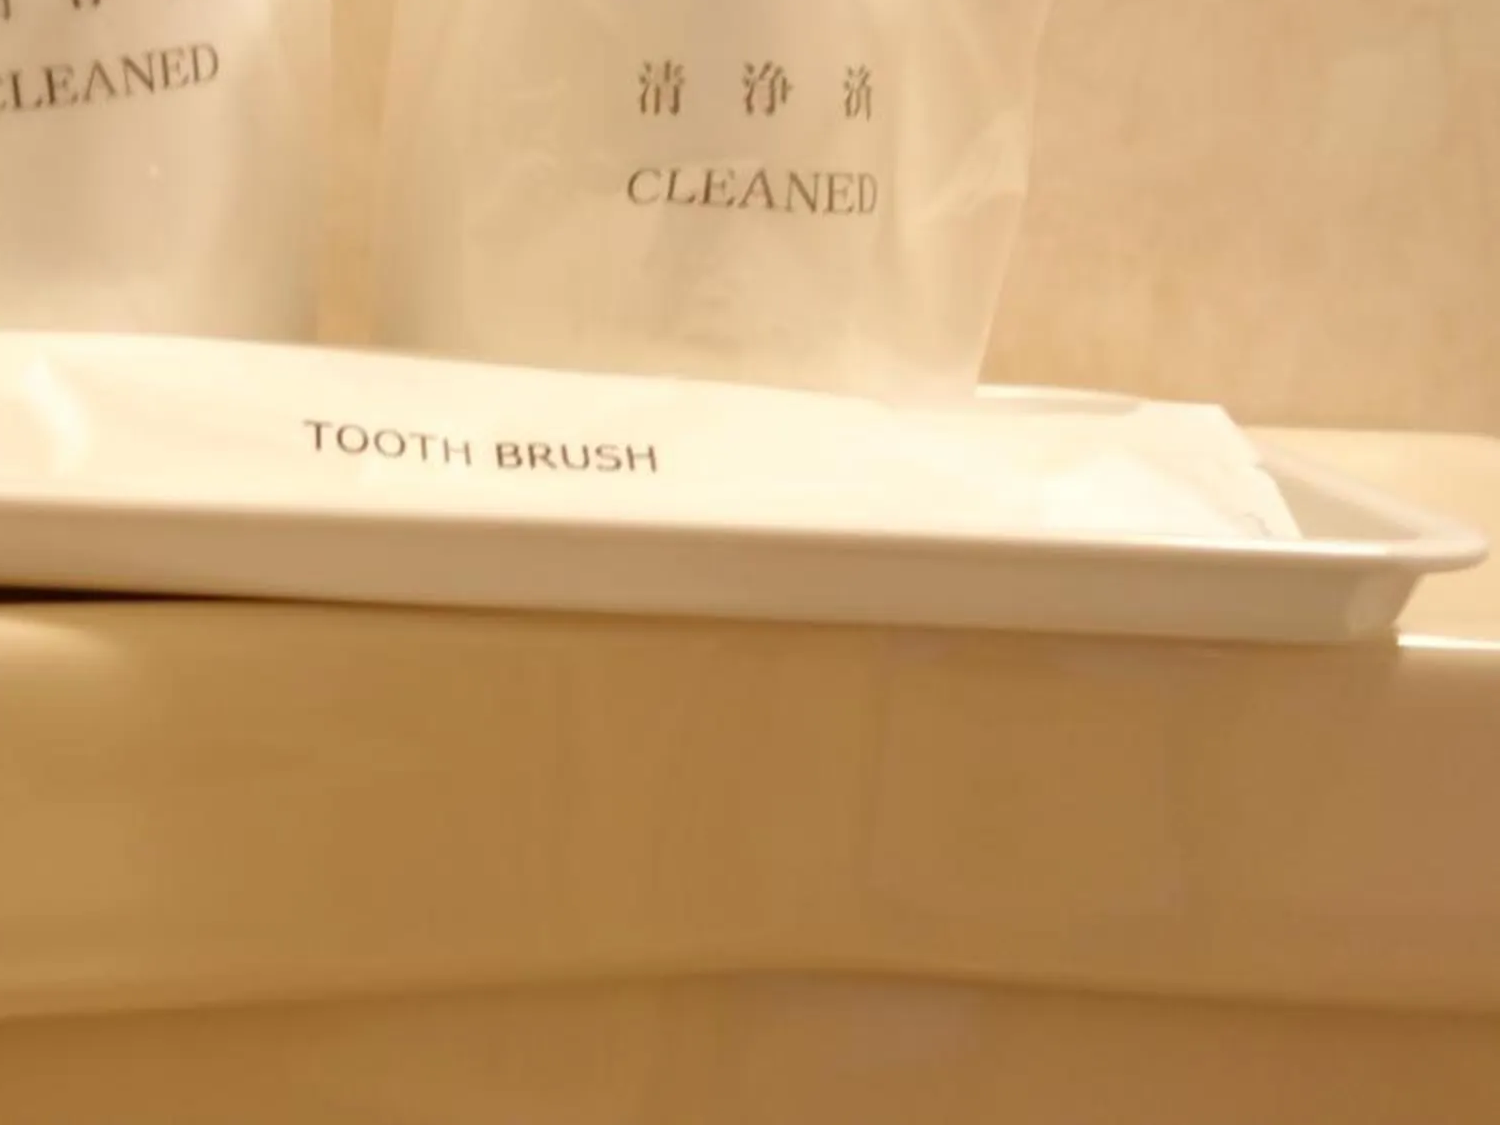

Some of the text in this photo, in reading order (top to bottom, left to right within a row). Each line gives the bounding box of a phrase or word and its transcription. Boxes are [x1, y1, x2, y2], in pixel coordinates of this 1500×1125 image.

[627, 167, 878, 215] CLEANED
[302, 419, 658, 473] TOOTH BRUSH
